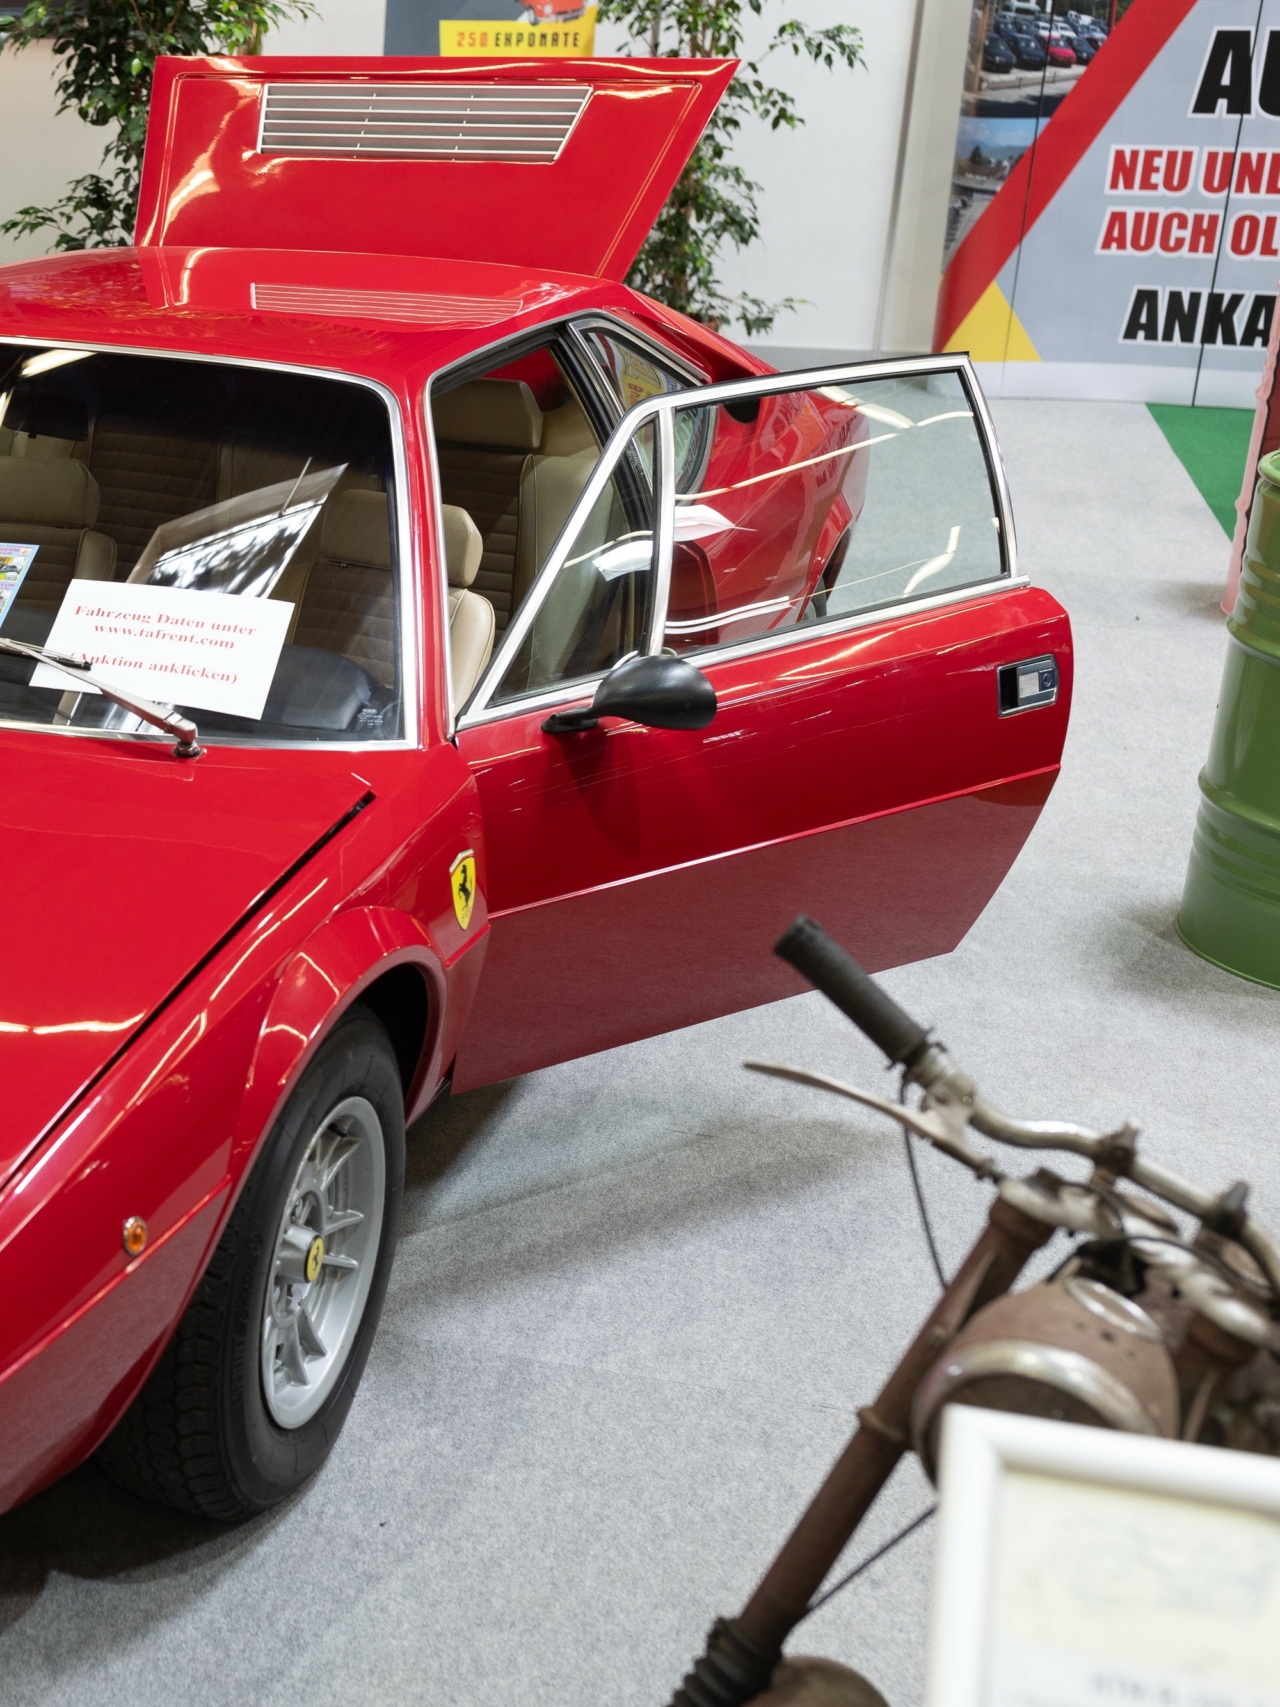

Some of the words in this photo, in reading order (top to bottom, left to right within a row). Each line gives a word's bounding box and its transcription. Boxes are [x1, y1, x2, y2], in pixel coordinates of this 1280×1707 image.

[457, 31, 488, 48] 250
[495, 31, 580, 48] EXPONATE
[1109, 149, 1194, 193] NEU
[1100, 211, 1220, 255] AUCH
[75, 605, 151, 624] Fahrzeug
[157, 613, 205, 629] Daten
[211, 622, 257, 635] unter
[94, 624, 235, 649] www.tafrent.com
[149, 663, 238, 685] anklicken)
